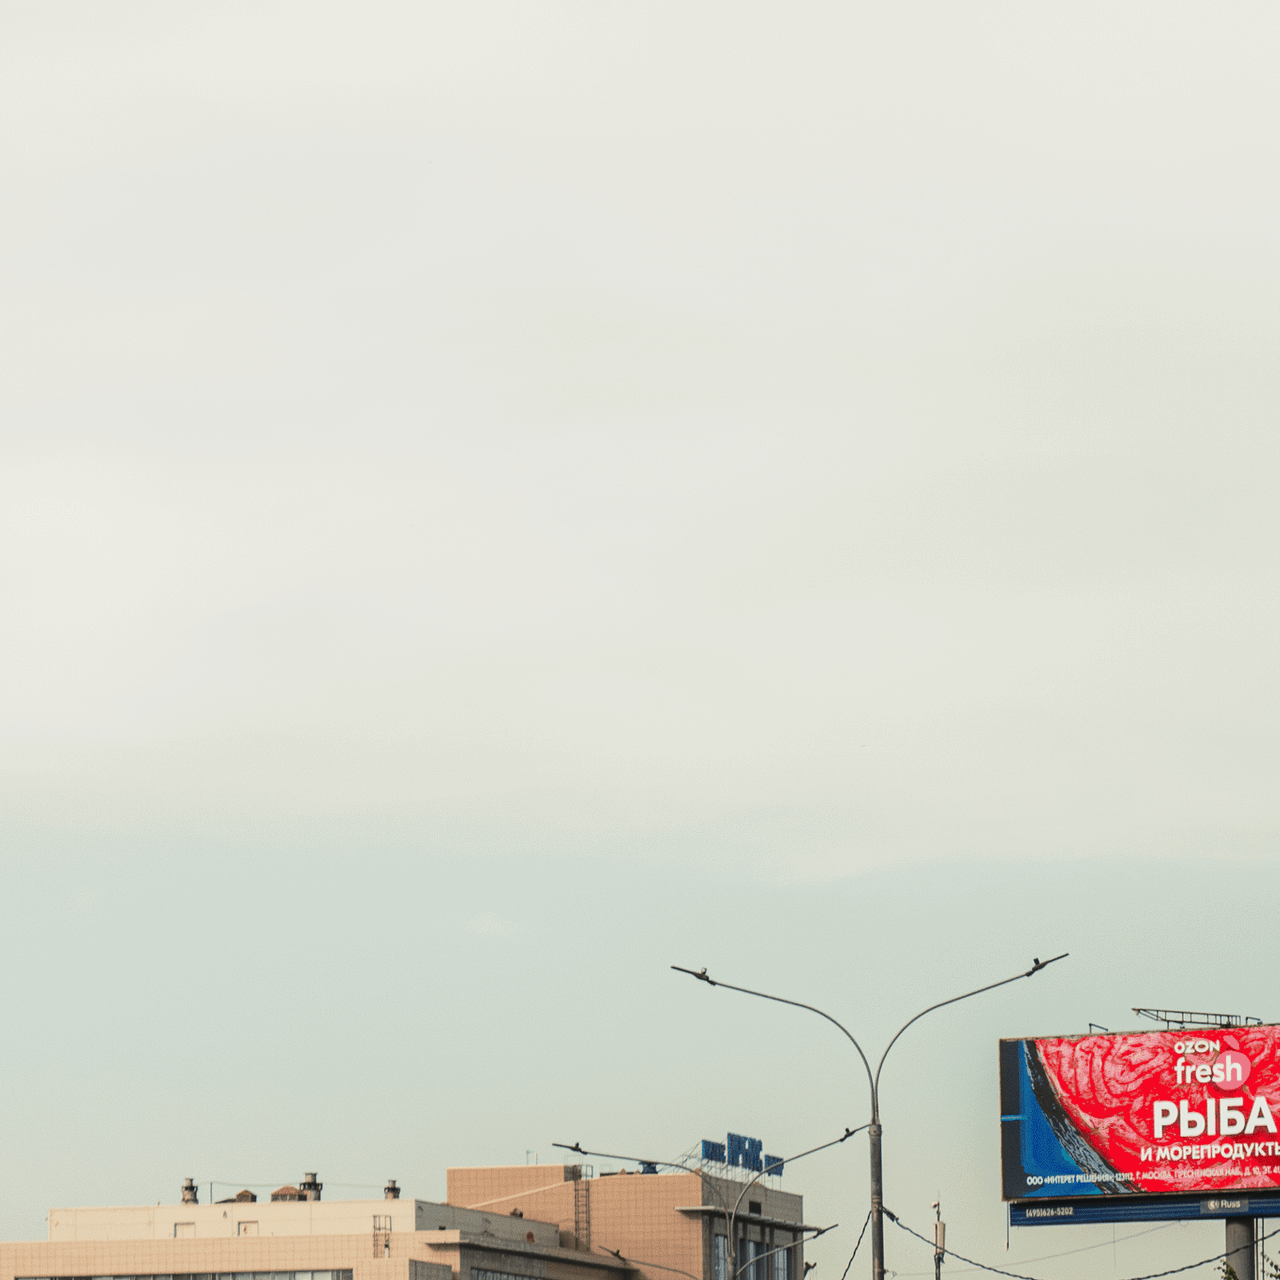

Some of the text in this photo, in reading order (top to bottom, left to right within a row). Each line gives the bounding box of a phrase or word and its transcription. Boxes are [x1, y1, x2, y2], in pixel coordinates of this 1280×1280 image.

[1174, 1039, 1220, 1054] OZON
[1174, 1054, 1242, 1084] fresh
[1153, 1095, 1278, 1138] РЫБА
[1140, 1147, 1152, 1161] И
[1026, 1175, 1043, 1186] ООО
